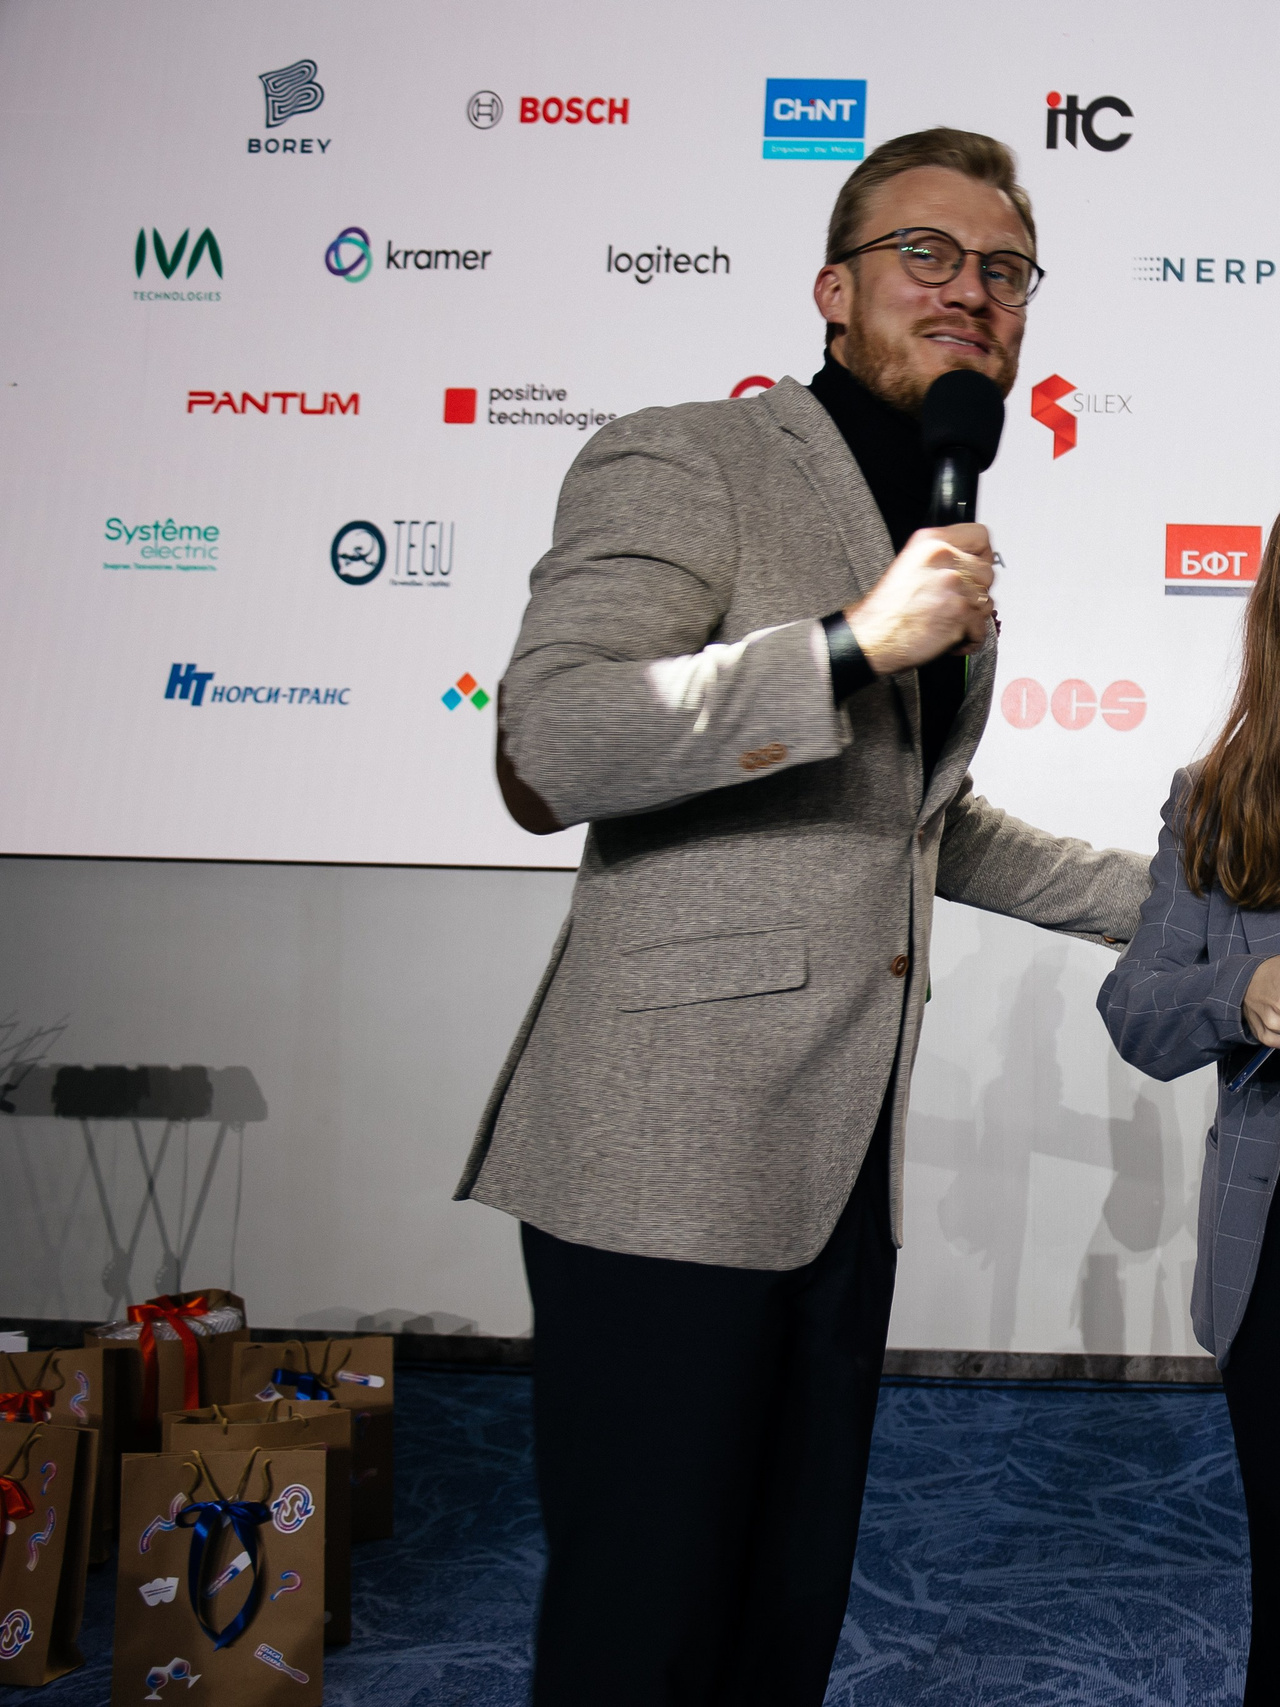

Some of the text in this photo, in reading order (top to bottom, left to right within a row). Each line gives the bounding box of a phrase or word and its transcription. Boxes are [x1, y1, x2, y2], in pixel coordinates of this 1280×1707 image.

[519, 96, 630, 125] BOSCH
[247, 138, 332, 154] BOREY
[135, 227, 223, 280] IVA
[385, 240, 492, 270] kramer
[607, 244, 731, 284] logitech
[133, 291, 222, 302] TECHNOLOGIES
[187, 391, 360, 415] PANTUM
[489, 384, 567, 404] positive
[1073, 392, 1133, 414] SILEX
[141, 542, 219, 560] electric
[393, 520, 454, 576] TEGU
[1181, 550, 1248, 576] БФТ
[211, 686, 350, 705] НОРСИ-ТРАНС
[1001, 677, 1147, 732] OCS
